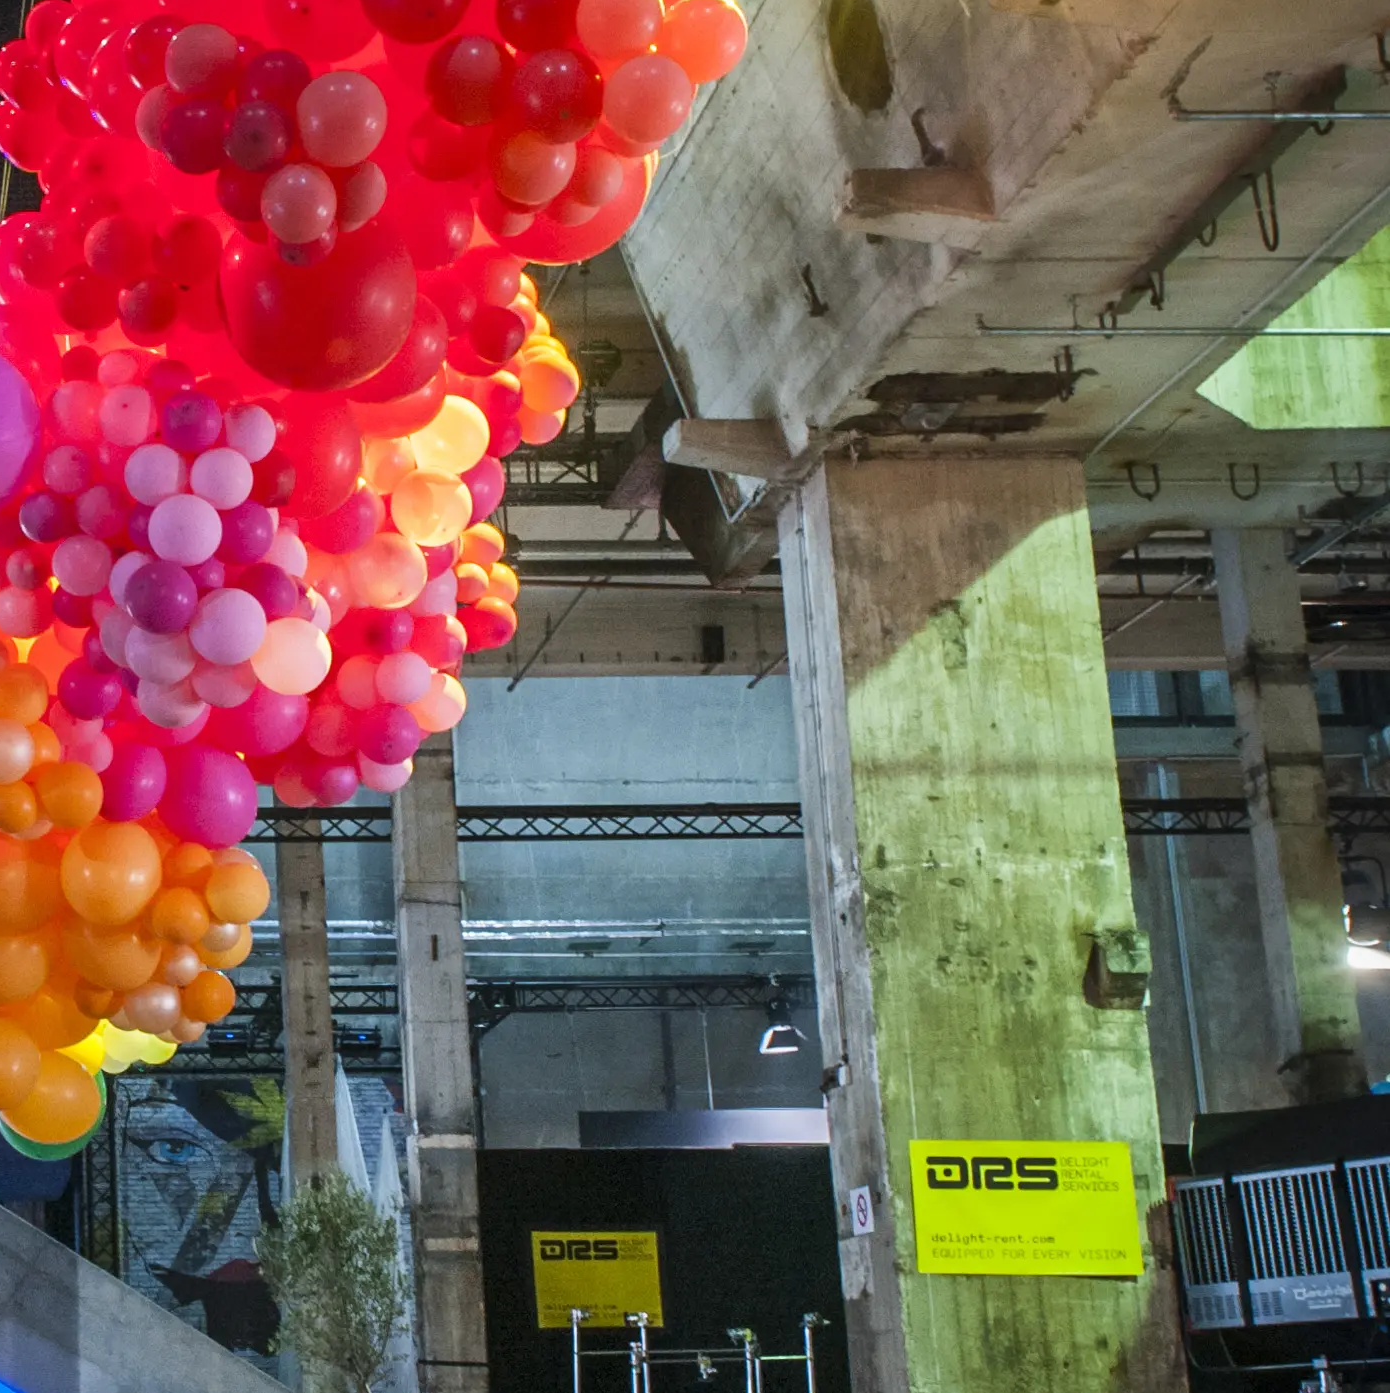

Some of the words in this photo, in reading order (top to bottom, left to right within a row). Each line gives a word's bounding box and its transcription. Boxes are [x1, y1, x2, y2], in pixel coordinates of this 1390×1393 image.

[1060, 1156, 1109, 1168] DELIGHT
[926, 1156, 1058, 1190] DRS
[1061, 1169, 1104, 1180] RENTAL
[1062, 1181, 1120, 1192] SERVICES
[931, 1233, 1056, 1246] delight-rent.com
[540, 1239, 618, 1260] DRS
[932, 1247, 995, 1260] EQUIPPED
[1002, 1248, 1025, 1260] FOR
[1033, 1248, 1071, 1260] EVERY
[1079, 1248, 1127, 1260] VISION
